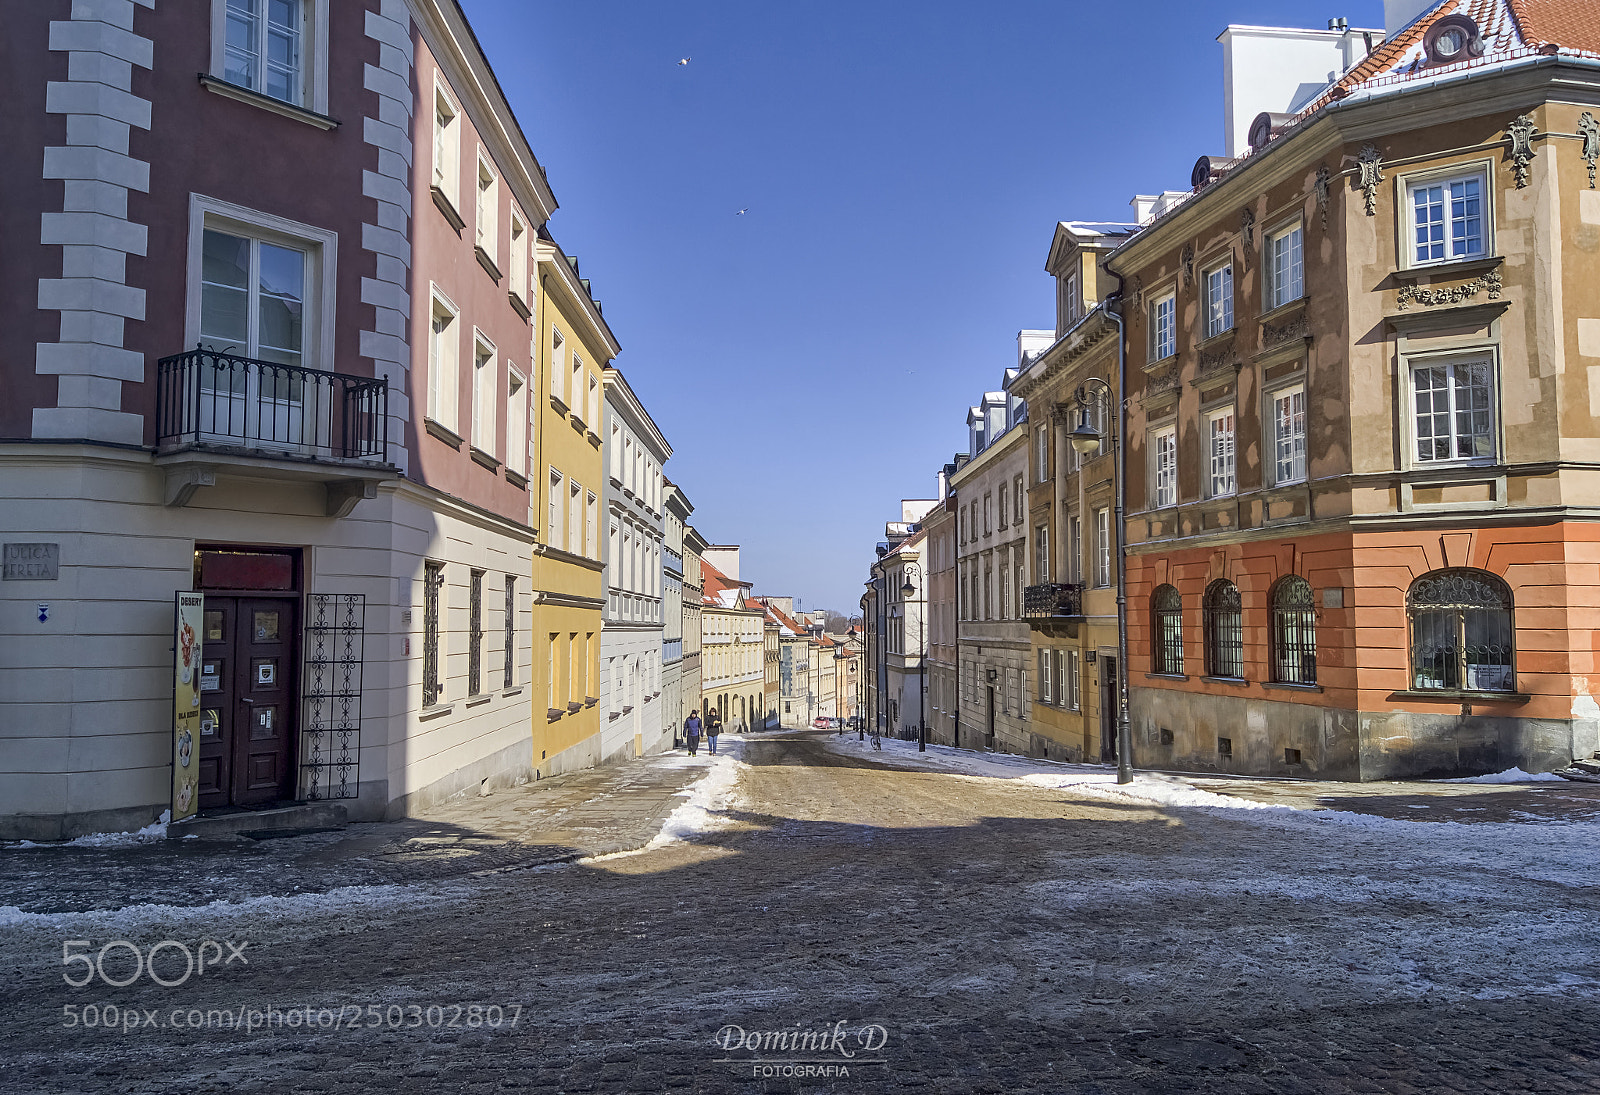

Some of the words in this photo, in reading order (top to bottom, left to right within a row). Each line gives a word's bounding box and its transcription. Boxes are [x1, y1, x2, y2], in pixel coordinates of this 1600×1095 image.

[10, 547, 51, 559] ULICA
[10, 564, 51, 576] FRETA
[181, 597, 202, 606] DESERY
